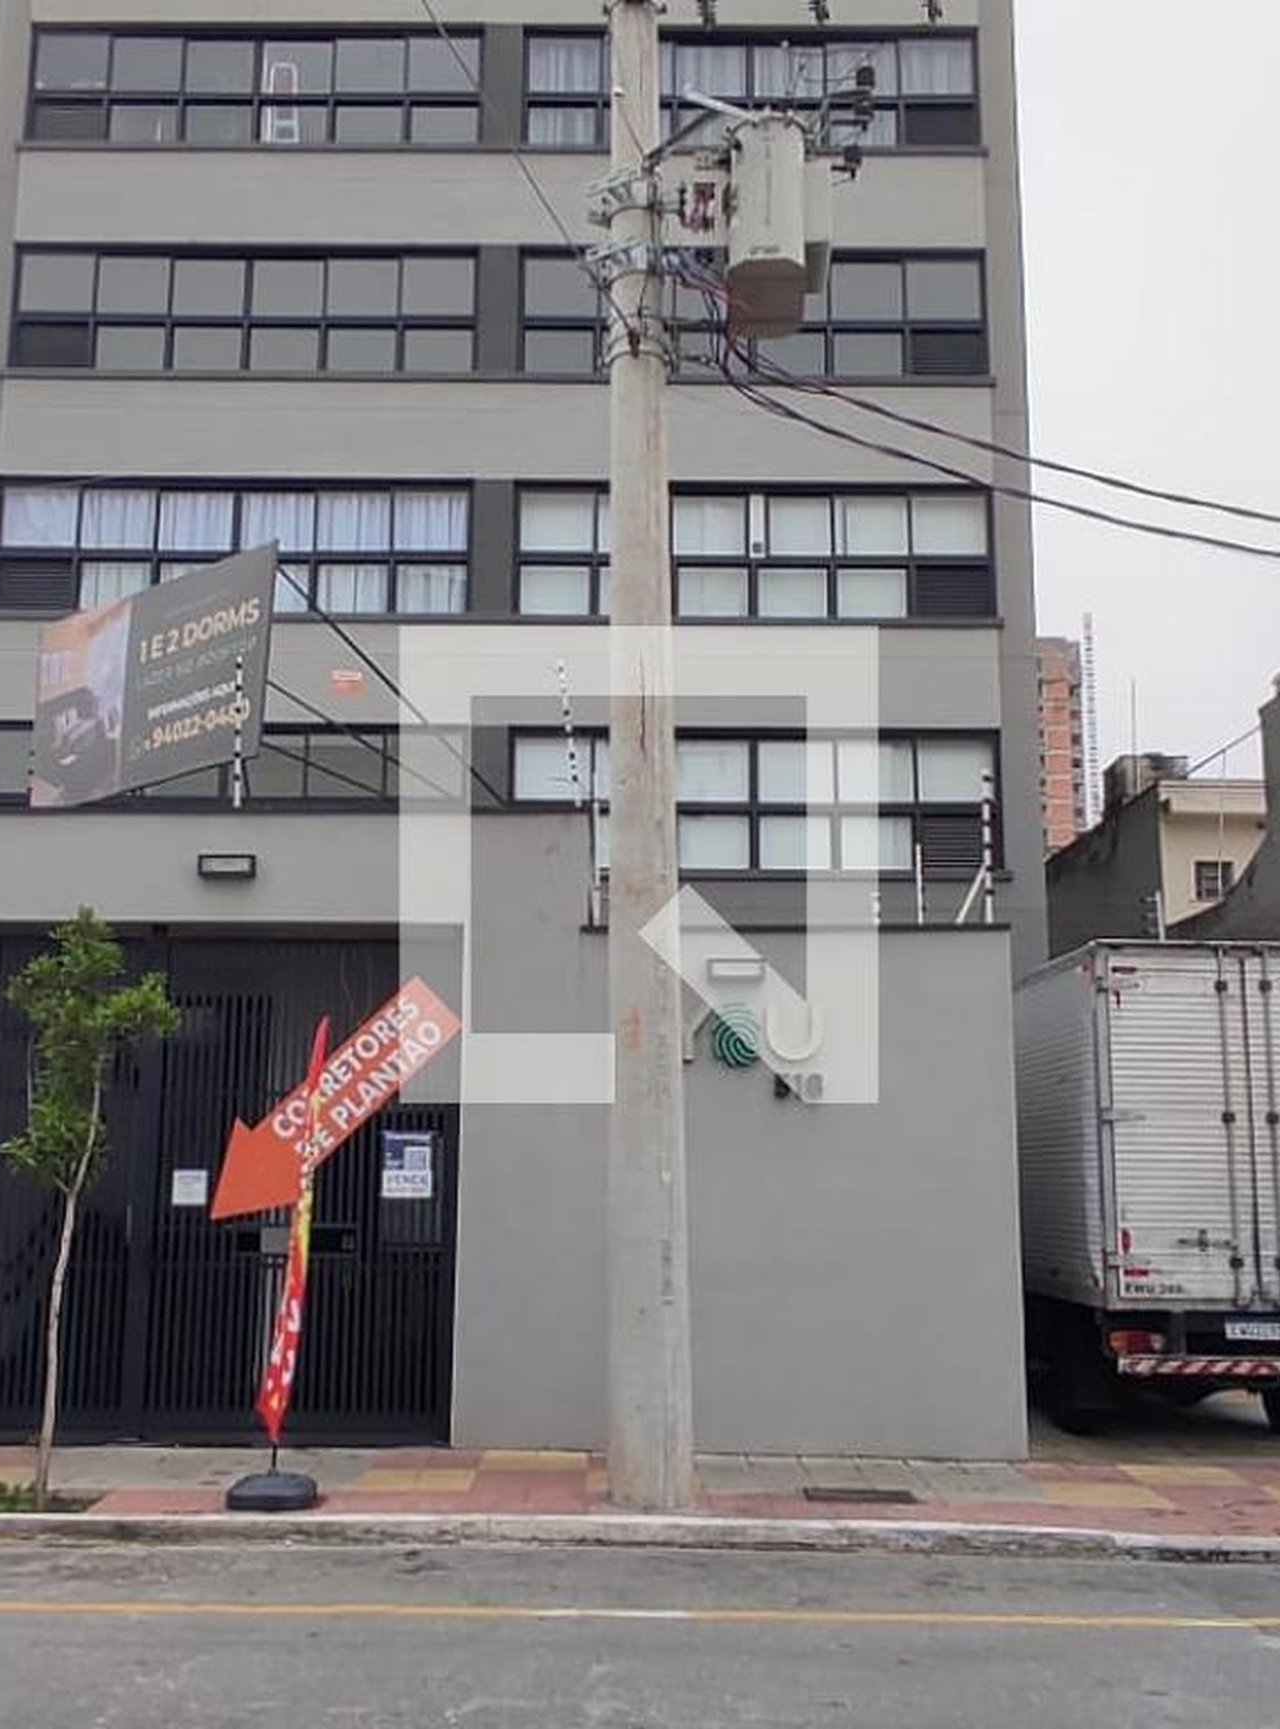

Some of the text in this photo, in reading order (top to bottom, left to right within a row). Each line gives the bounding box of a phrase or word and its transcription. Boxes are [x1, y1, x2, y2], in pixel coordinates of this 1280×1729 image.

[150, 633, 164, 660] E
[166, 628, 179, 653] 2
[181, 597, 260, 648] DORMS
[272, 996, 417, 1137] CORETORES
[329, 1020, 442, 1130] PLANTÃO
